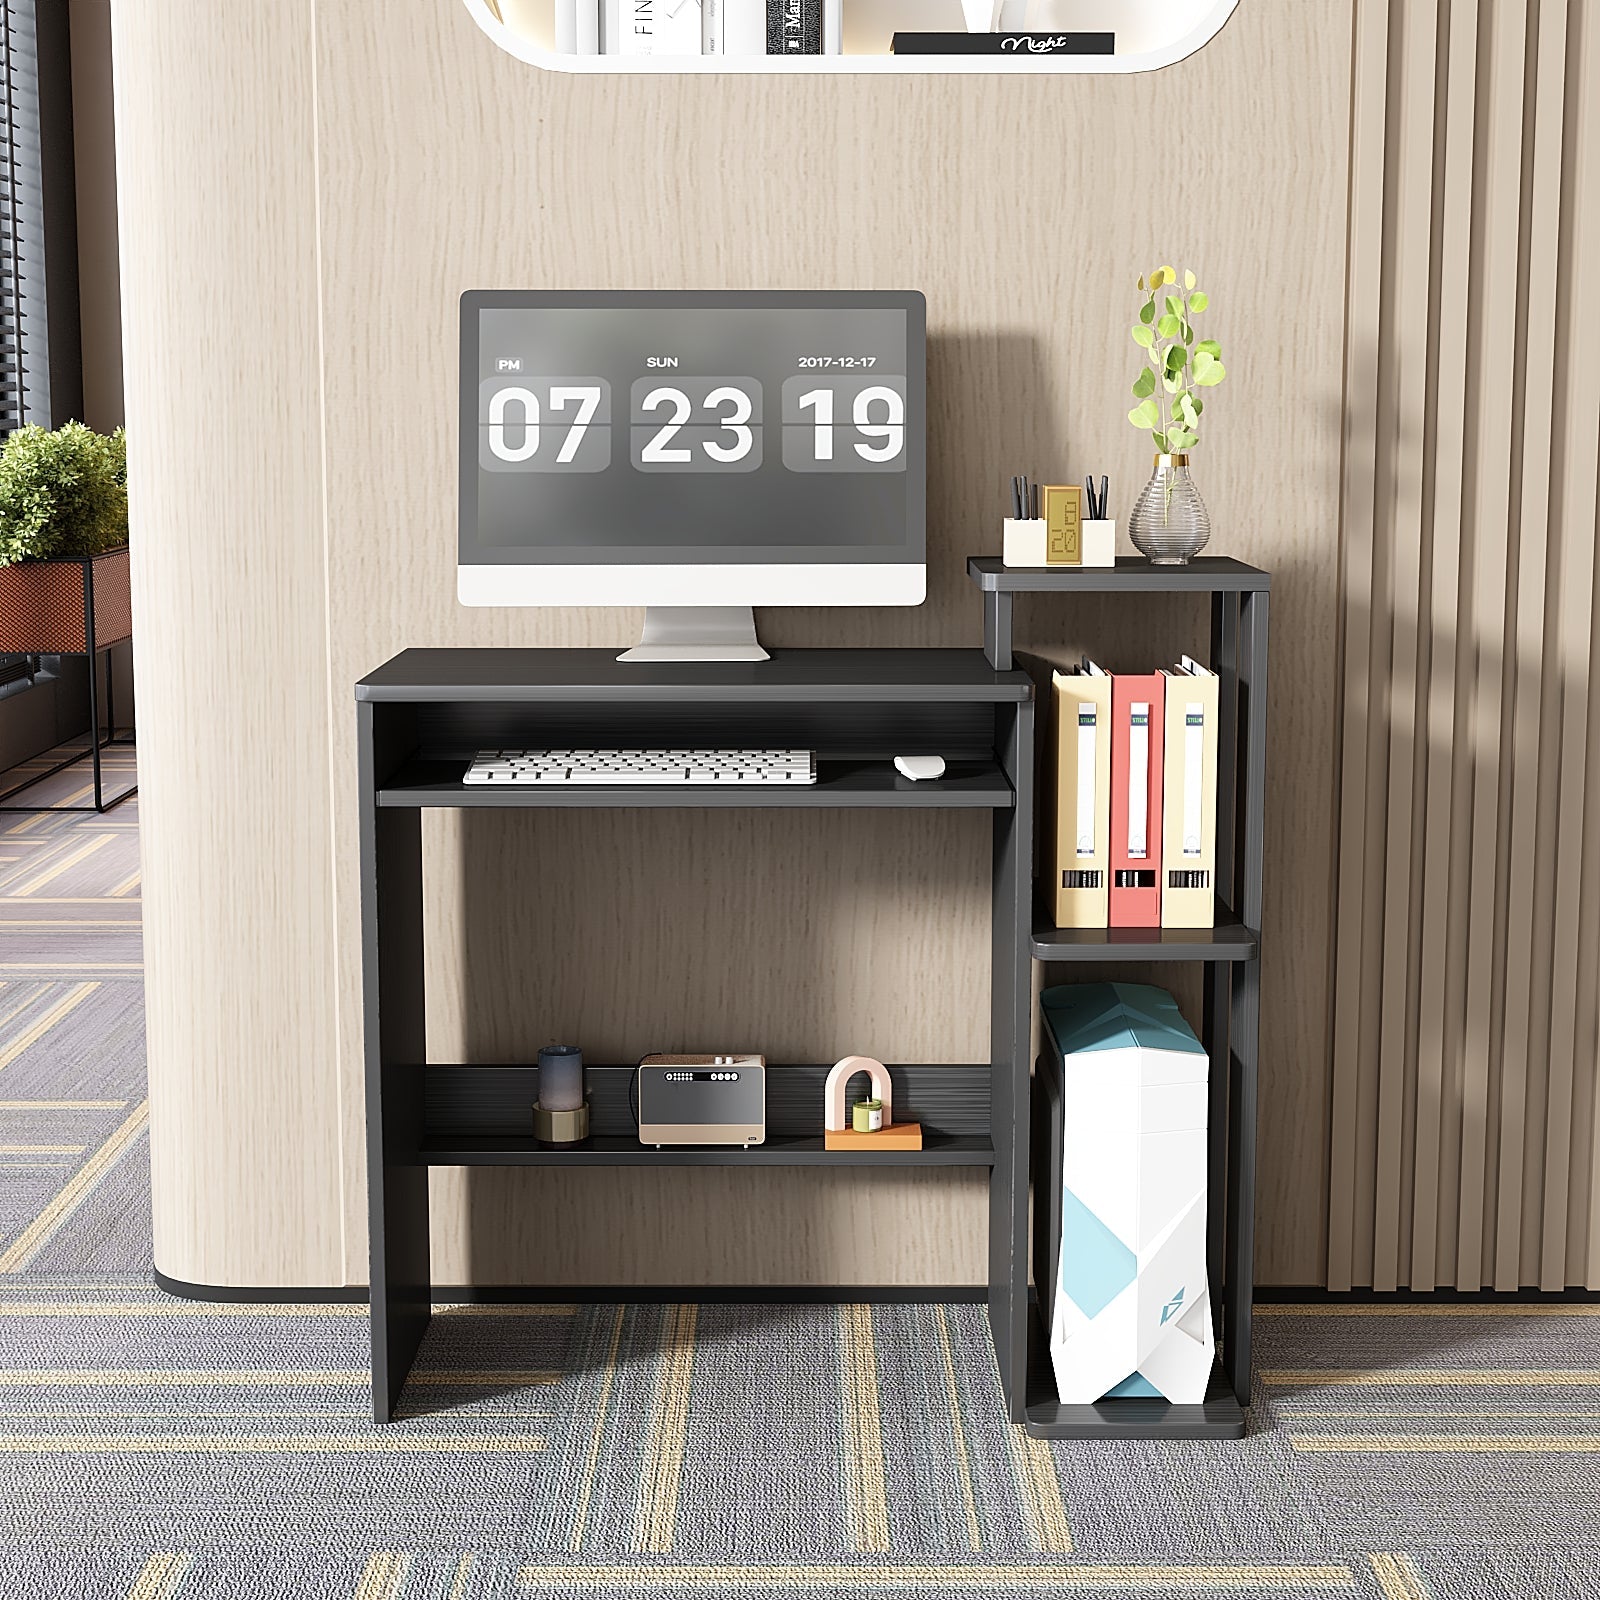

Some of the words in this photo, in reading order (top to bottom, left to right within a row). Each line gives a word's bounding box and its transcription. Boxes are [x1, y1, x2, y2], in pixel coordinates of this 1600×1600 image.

[498, 359, 520, 370] PM
[646, 356, 679, 368] SUN
[798, 357, 877, 368] 2017-12-17
[488, 386, 601, 463] 07
[641, 386, 753, 463] 23
[799, 386, 904, 463] 19
